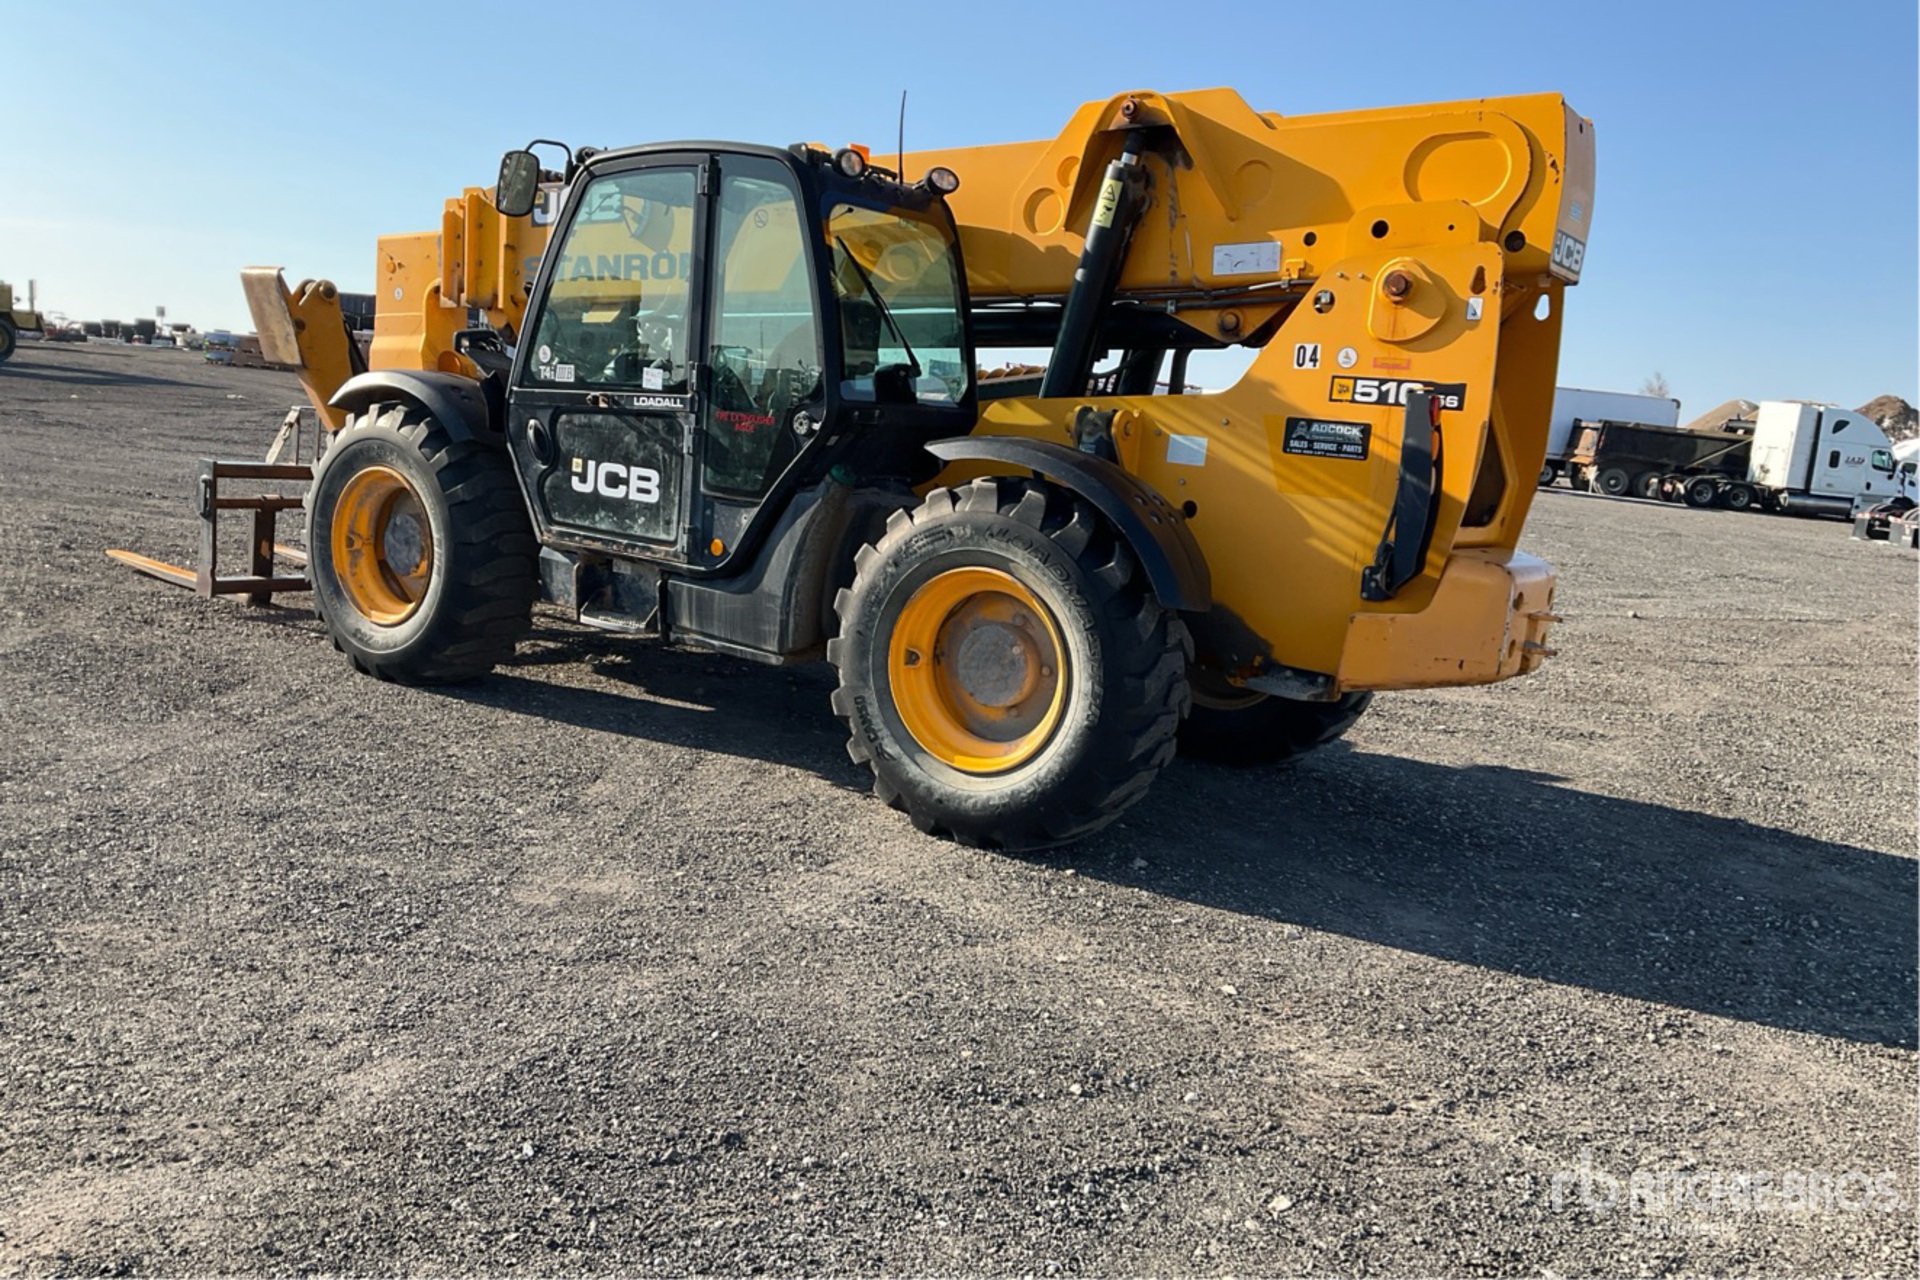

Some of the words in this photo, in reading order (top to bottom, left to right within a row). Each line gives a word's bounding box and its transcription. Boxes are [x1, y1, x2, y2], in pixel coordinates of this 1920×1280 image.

[1554, 234, 1585, 272] JCB
[1296, 345, 1318, 368] 04
[633, 396, 684, 408] LOADALL
[1311, 423, 1363, 437] ADCOCK
[1289, 439, 1309, 449] SALES
[1312, 441, 1338, 452] SERVICE
[1341, 444, 1363, 454] PARTS
[571, 459, 660, 503] JCB
[854, 694, 880, 743] CAMSO
